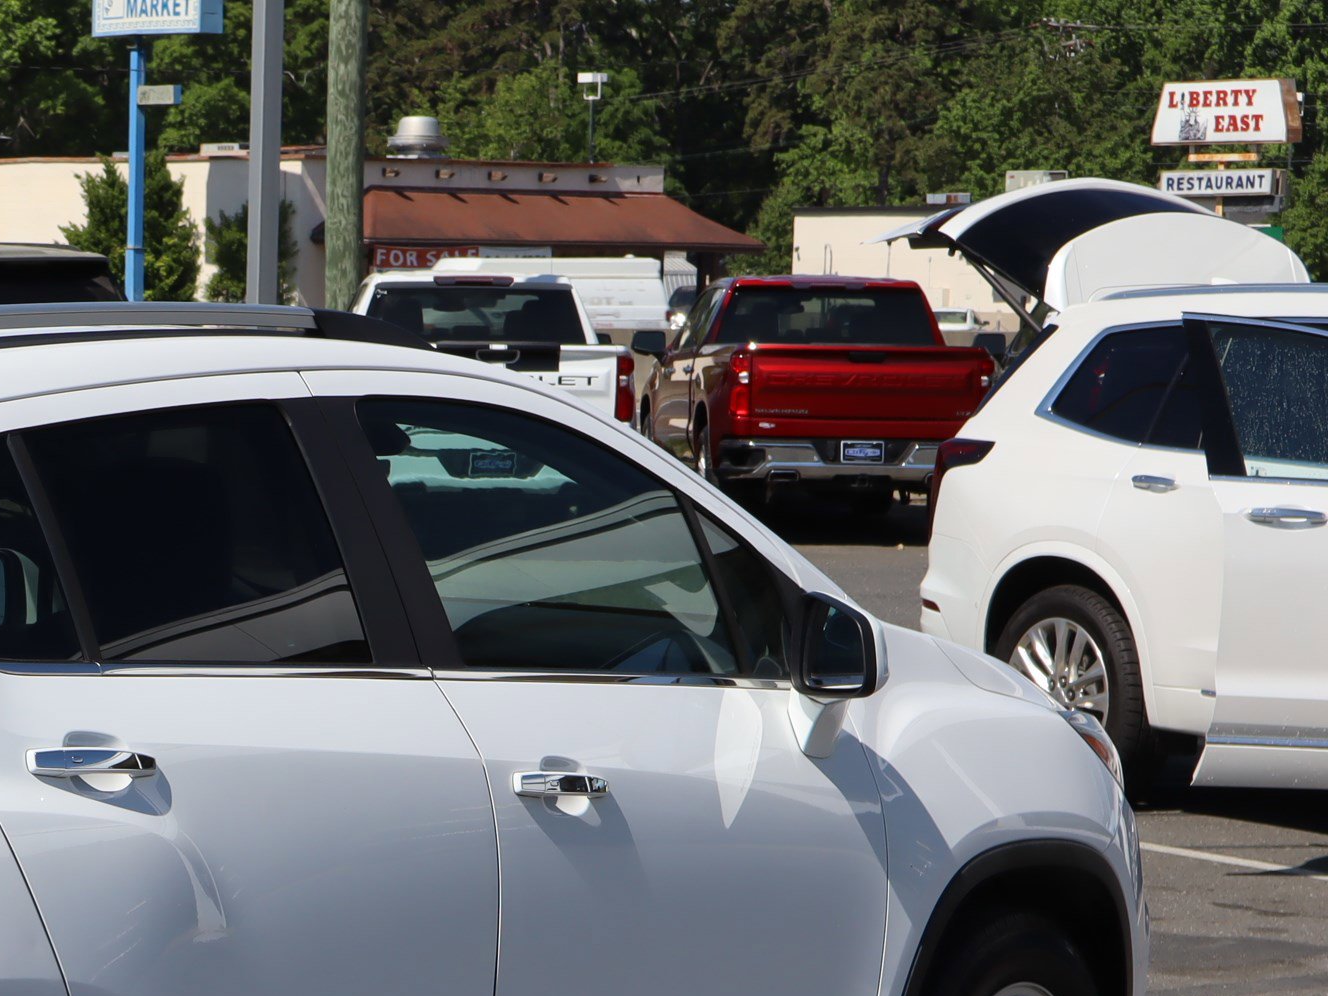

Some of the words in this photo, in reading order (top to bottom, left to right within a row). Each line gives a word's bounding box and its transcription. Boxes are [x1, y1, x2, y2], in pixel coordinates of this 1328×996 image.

[1213, 114, 1264, 133] EAST
[1166, 175, 1266, 191] RESTAURANT
[376, 249, 418, 267] FOR
